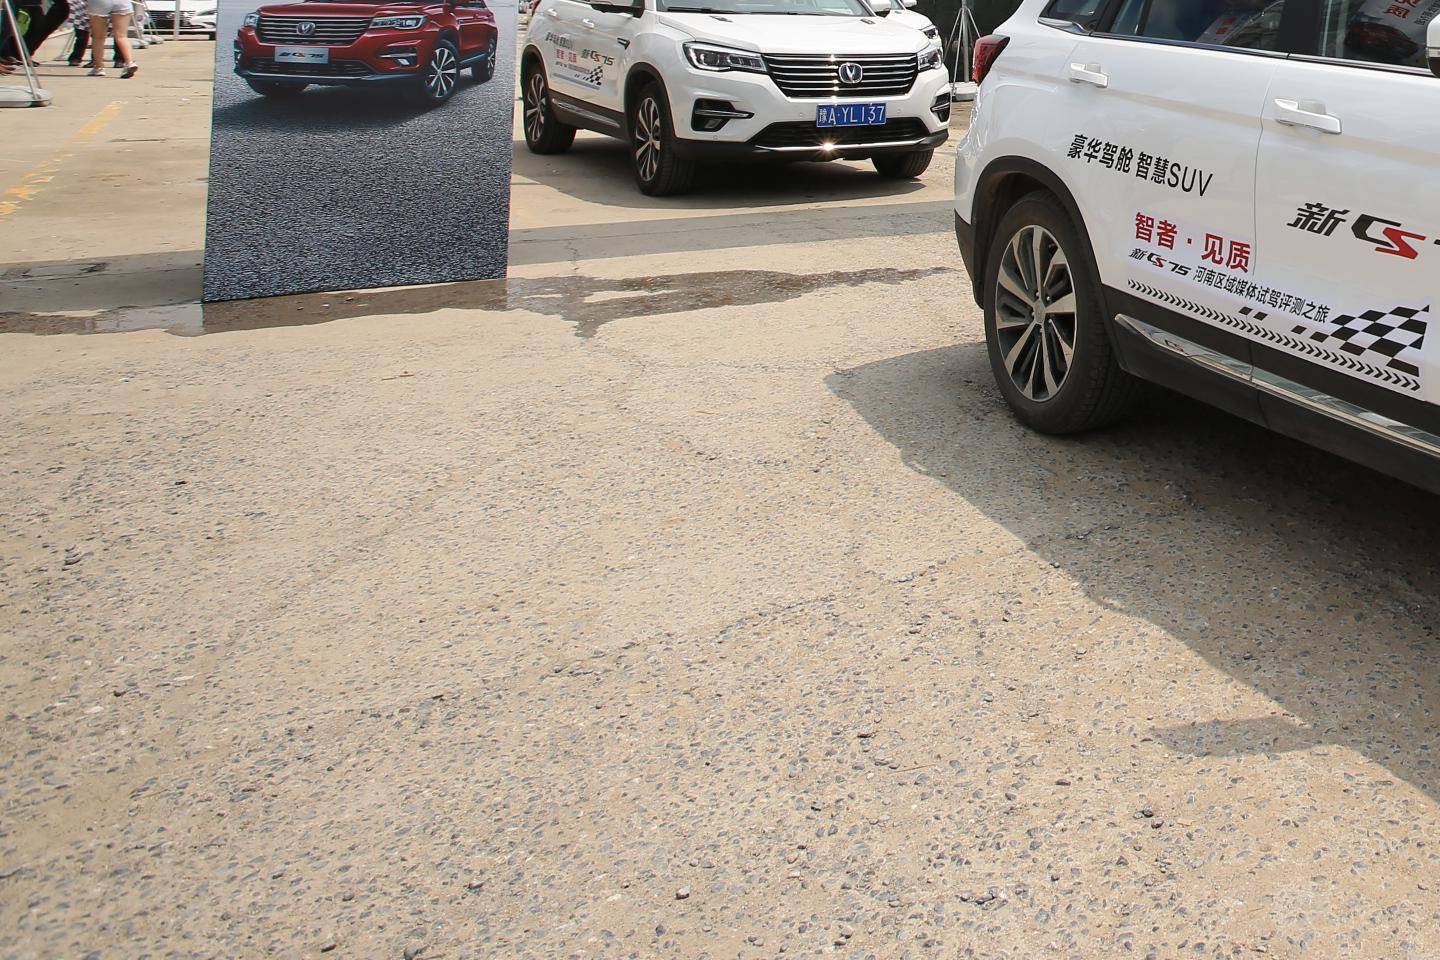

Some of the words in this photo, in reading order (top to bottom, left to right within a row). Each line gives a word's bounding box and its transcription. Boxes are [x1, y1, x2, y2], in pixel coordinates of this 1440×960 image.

[1067, 134, 1134, 174] 豪华驾舱
[1135, 152, 1213, 197] 智慧SUV
[1135, 212, 1251, 274] 智者·见质
[1193, 265, 1331, 324] 河南区域媒体试驾评测之旅
